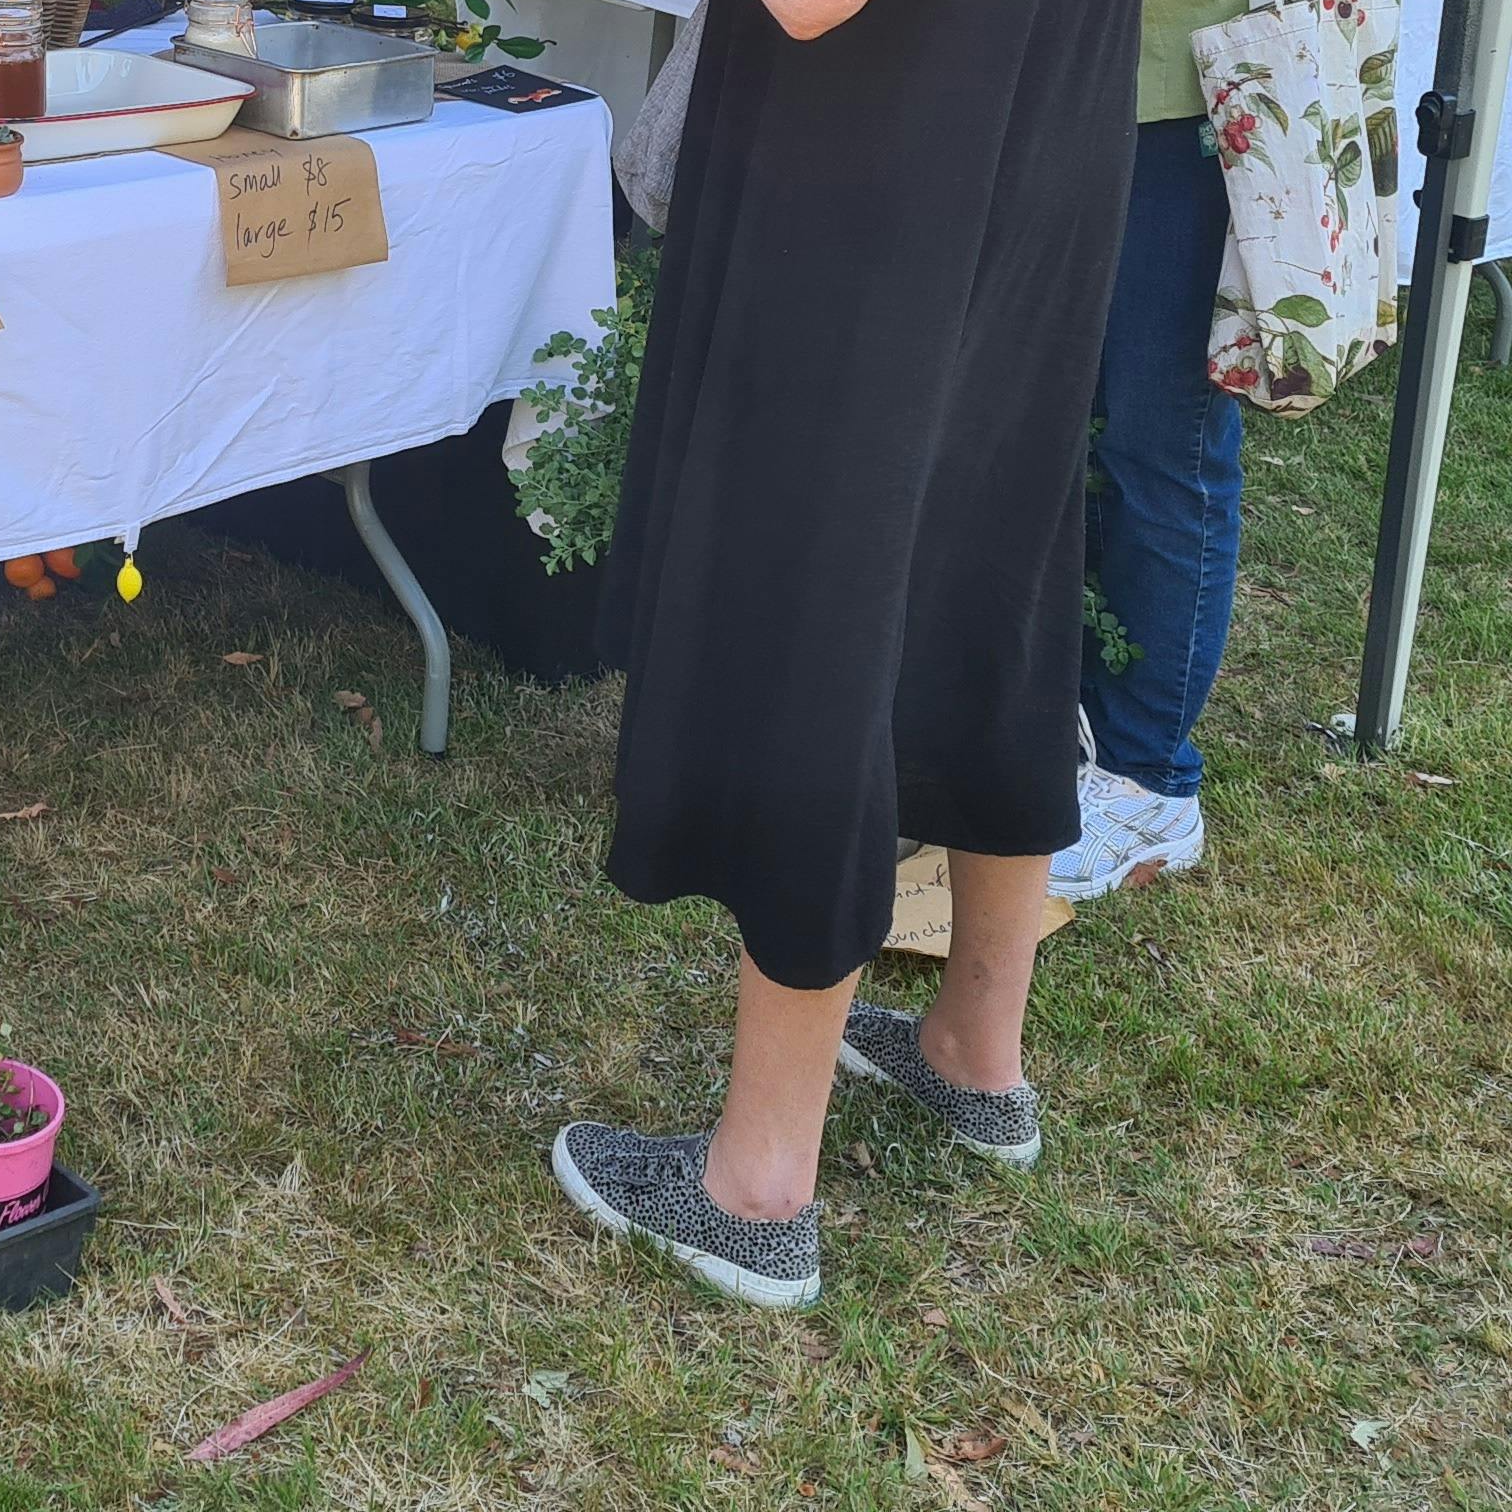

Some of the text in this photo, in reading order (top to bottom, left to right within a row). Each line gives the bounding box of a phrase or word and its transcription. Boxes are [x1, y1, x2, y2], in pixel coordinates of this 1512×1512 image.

[302, 154, 332, 196] $8
[236, 197, 352, 258] large $15
